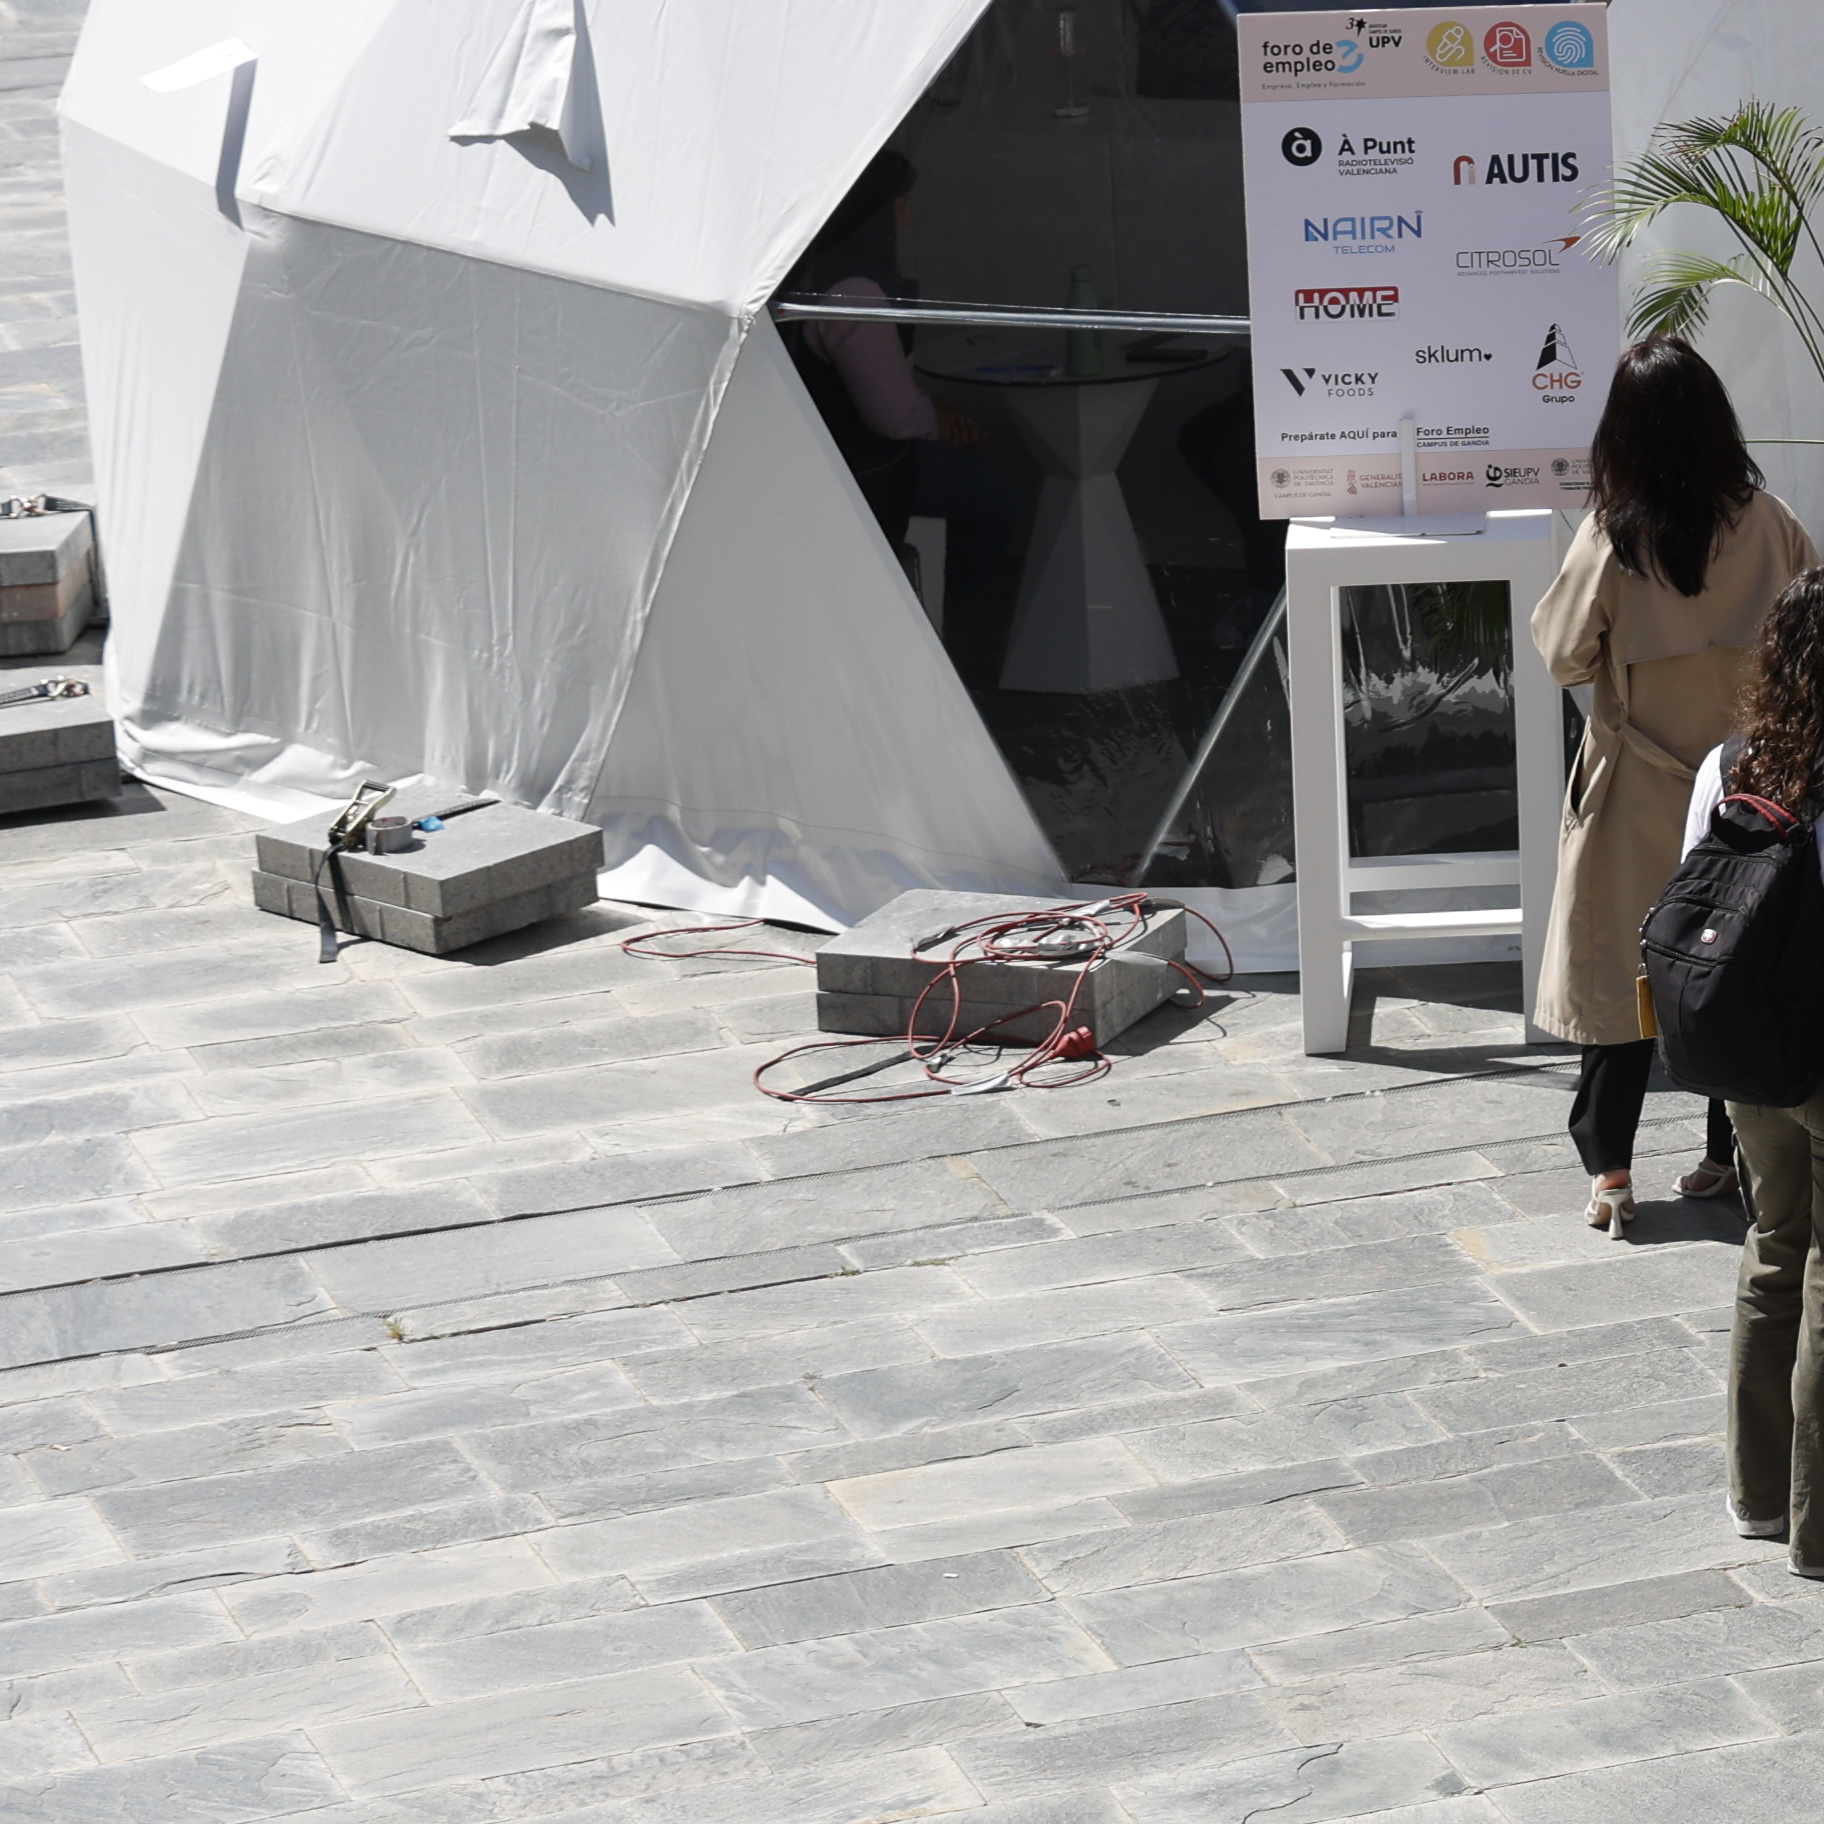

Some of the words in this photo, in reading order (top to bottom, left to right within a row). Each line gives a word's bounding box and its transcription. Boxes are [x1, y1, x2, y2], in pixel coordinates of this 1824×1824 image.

[1262, 41, 1303, 56] foro
[1310, 40, 1334, 55] de
[1369, 36, 1402, 49] UPV
[1262, 57, 1336, 77] empleo
[1338, 133, 1356, 156] À
[1363, 137, 1416, 155] Punt
[1338, 157, 1414, 167] RADIOTELEVISIÓ
[1485, 152, 1579, 184] AUTIS
[1338, 167, 1398, 176] VALENCIANA
[1304, 211, 1423, 242] NAIRN
[1333, 244, 1395, 255] TELECOM
[1456, 249, 1560, 268] CITROSOL
[1298, 290, 1396, 320] HOME
[1415, 345, 1482, 364] sklum
[1321, 372, 1379, 385] VICKY
[1532, 371, 1583, 390] CHG
[1328, 387, 1374, 397] FOODS
[1542, 394, 1575, 404] Grupo
[1281, 431, 1336, 443] Prepárate
[1339, 428, 1369, 440] AQUÍ
[1372, 430, 1397, 441] para
[1416, 427, 1442, 436] Foro
[1446, 425, 1490, 437] Empleo
[1360, 473, 1402, 481] GENERALIT
[1422, 471, 1475, 482] LABORA
[1503, 468, 1540, 478] SIEUPV
[1504, 477, 1540, 486] GANDIA
